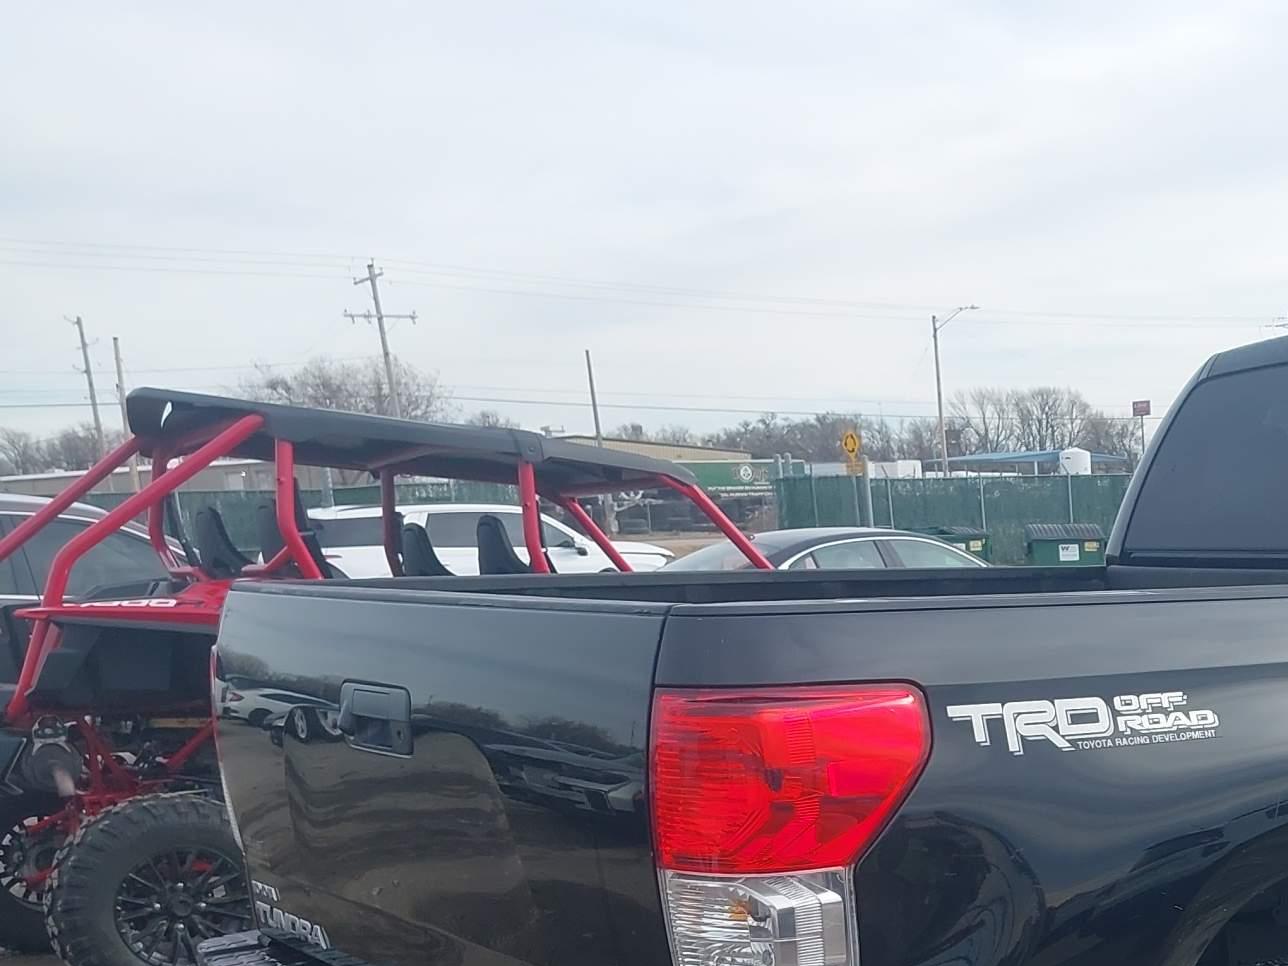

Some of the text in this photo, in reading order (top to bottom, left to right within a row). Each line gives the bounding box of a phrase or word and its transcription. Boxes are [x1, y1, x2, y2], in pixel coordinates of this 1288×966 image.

[946, 692, 1187, 755] TRD OFF
[1117, 709, 1220, 734] ROAD
[1077, 730, 1217, 750] TOYOTA RACING DEVELOPMENT
[255, 901, 330, 949] TUNDRA
